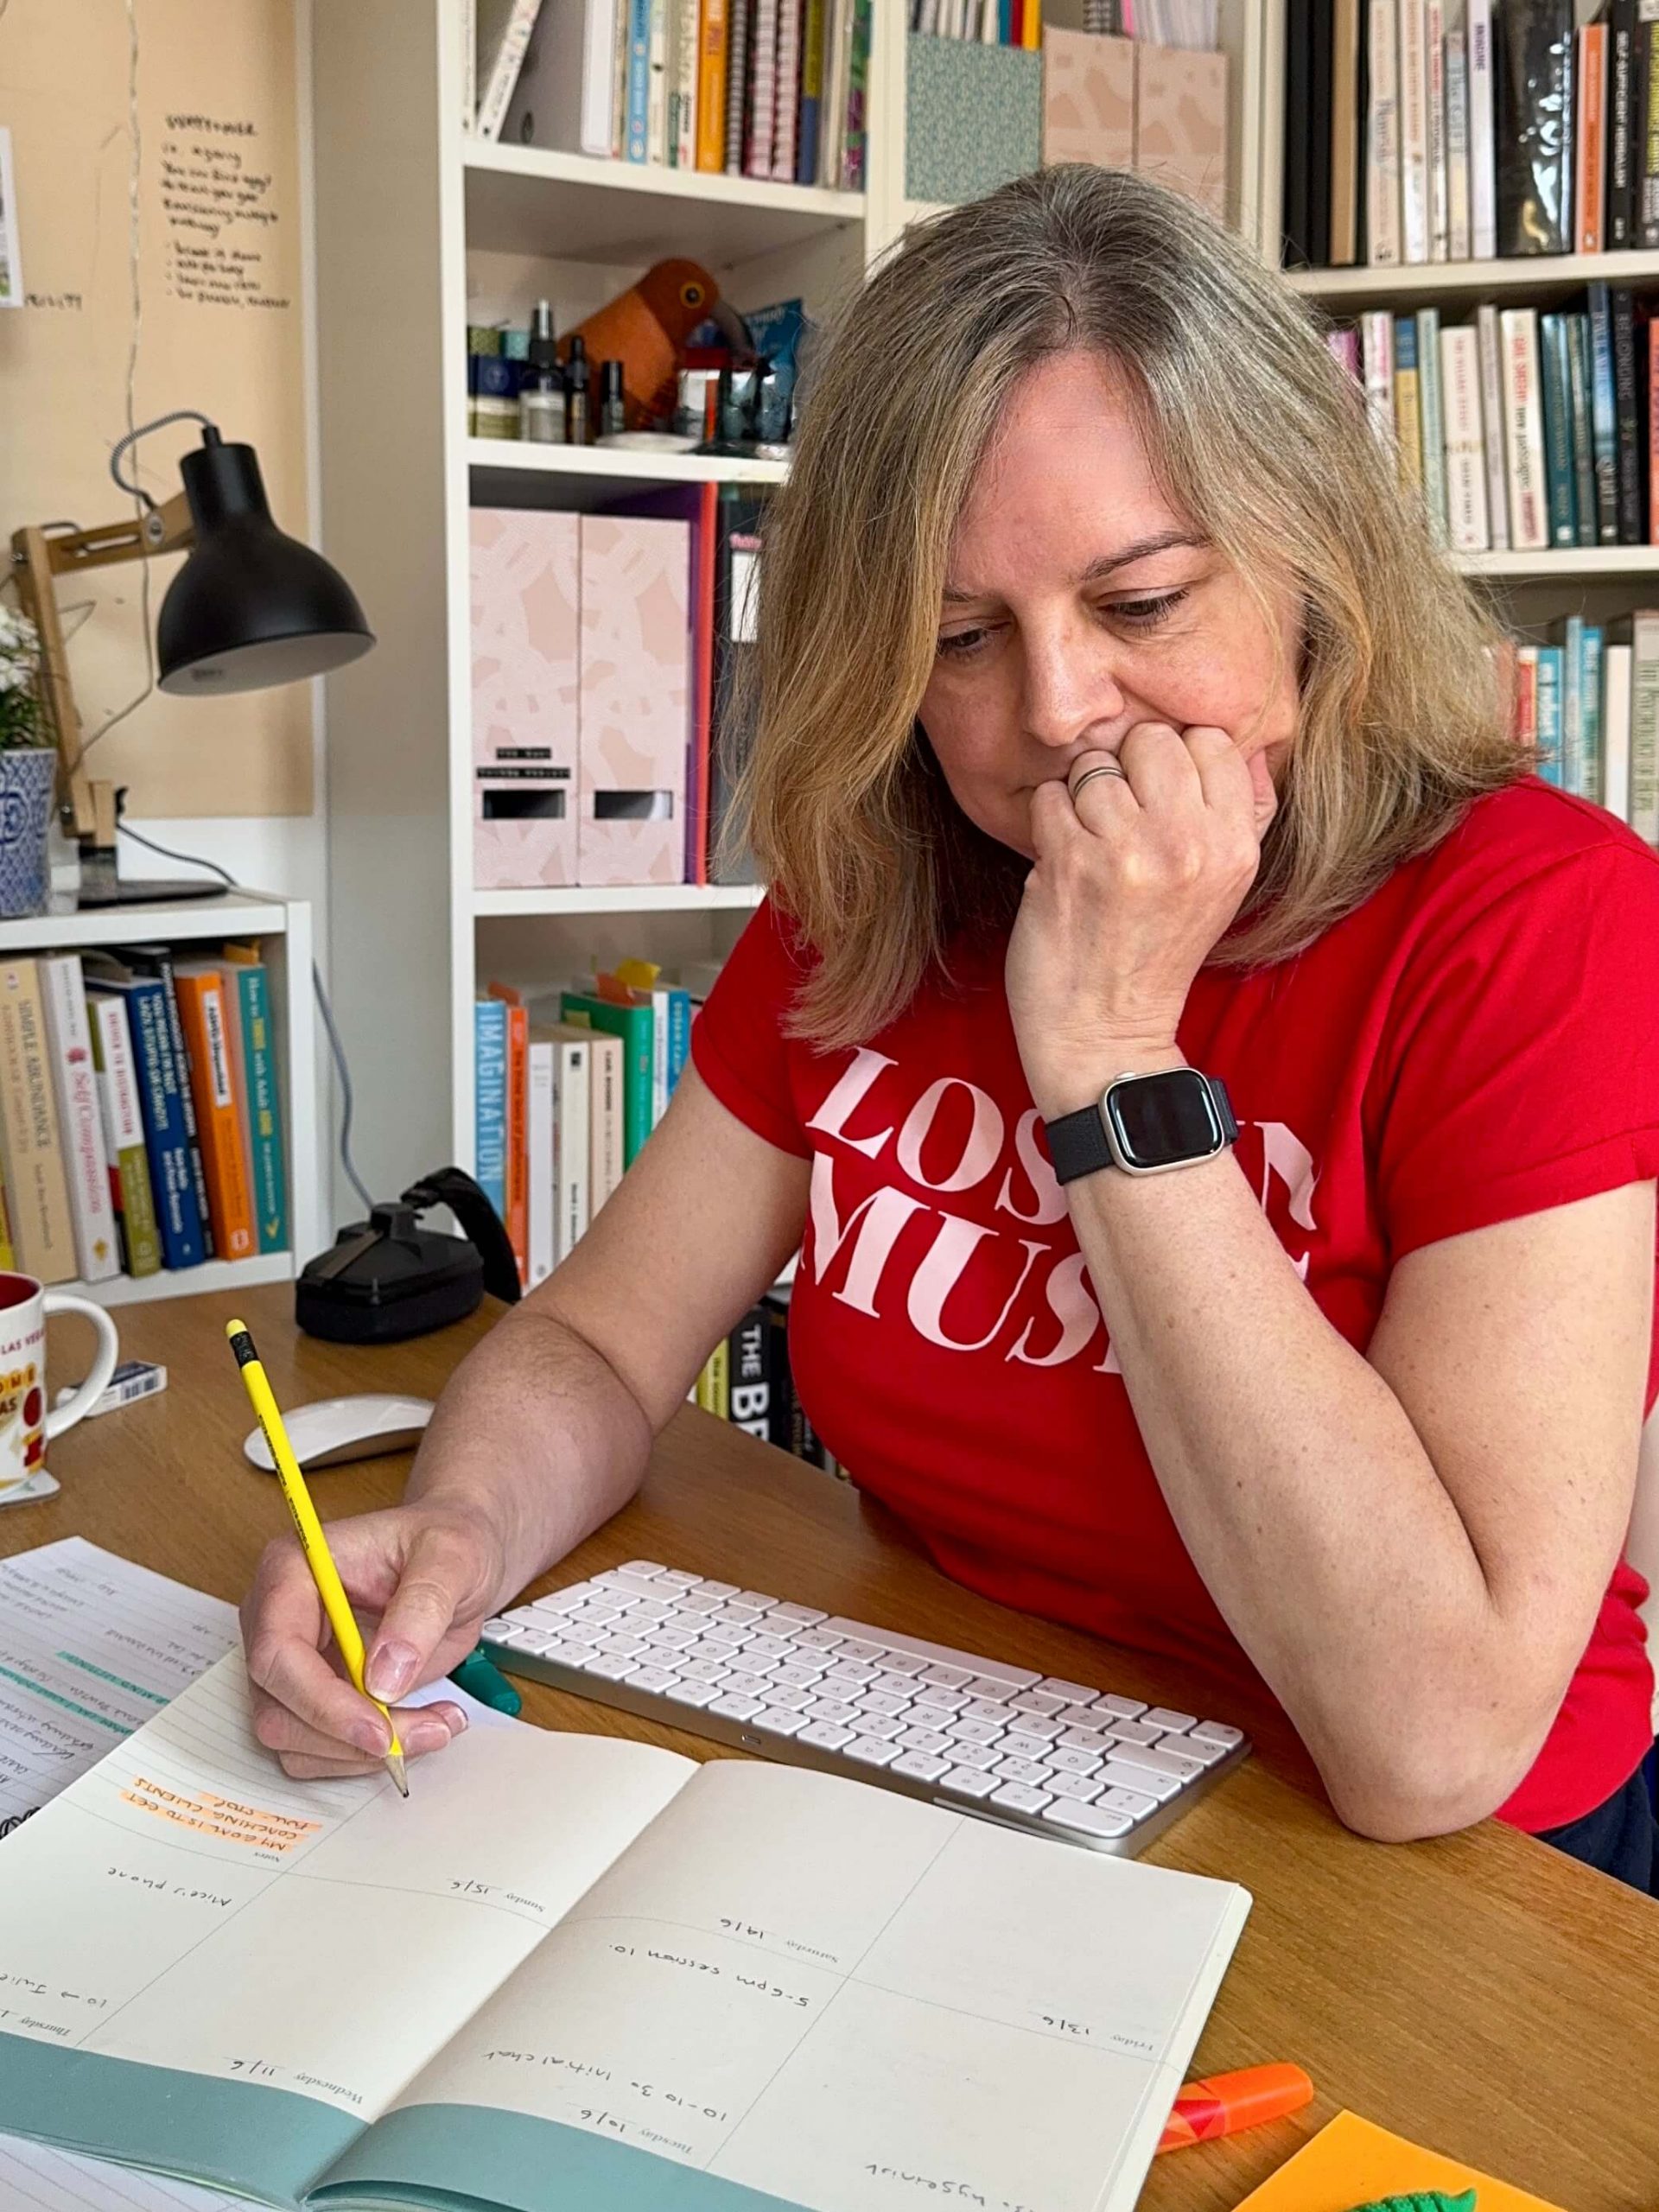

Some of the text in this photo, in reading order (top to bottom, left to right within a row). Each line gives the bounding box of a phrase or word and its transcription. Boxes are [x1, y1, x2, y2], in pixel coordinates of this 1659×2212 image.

[1616, 311, 1636, 402] BELONGING
[247, 976, 260, 1002] How
[255, 1051, 268, 1078] with
[257, 1079, 270, 1109] Adult
[477, 1012, 505, 1183] IMAGINATION
[805, 1047, 1070, 1226] LOS
[1, 1338, 22, 1355] LAS
[741, 1324, 762, 1377] THE
[126, 1793, 160, 1811] GET
[133, 1777, 298, 1841] COACHING CLIENTS
[209, 1825, 257, 1843] GOAL
[260, 1838, 287, 1852] MY
[106, 1866, 168, 1890] phone
[450, 1878, 490, 1895] 15/6
[504, 1891, 546, 1913] Sunday
[720, 1917, 764, 1940] 14/6
[785, 1939, 839, 1964] Saturday
[86, 1997, 107, 2009] 10
[19, 2015, 73, 2037] Thursday
[1041, 2016, 1090, 2035] 13/6
[1109, 2033, 1154, 2052] Friday
[483, 2050, 535, 2062] chat
[231, 2059, 276, 2077] 11/6
[292, 2071, 364, 2106] Wednesday
[580, 2109, 626, 2133] 10/6
[638, 2127, 694, 2155] Tuesday
